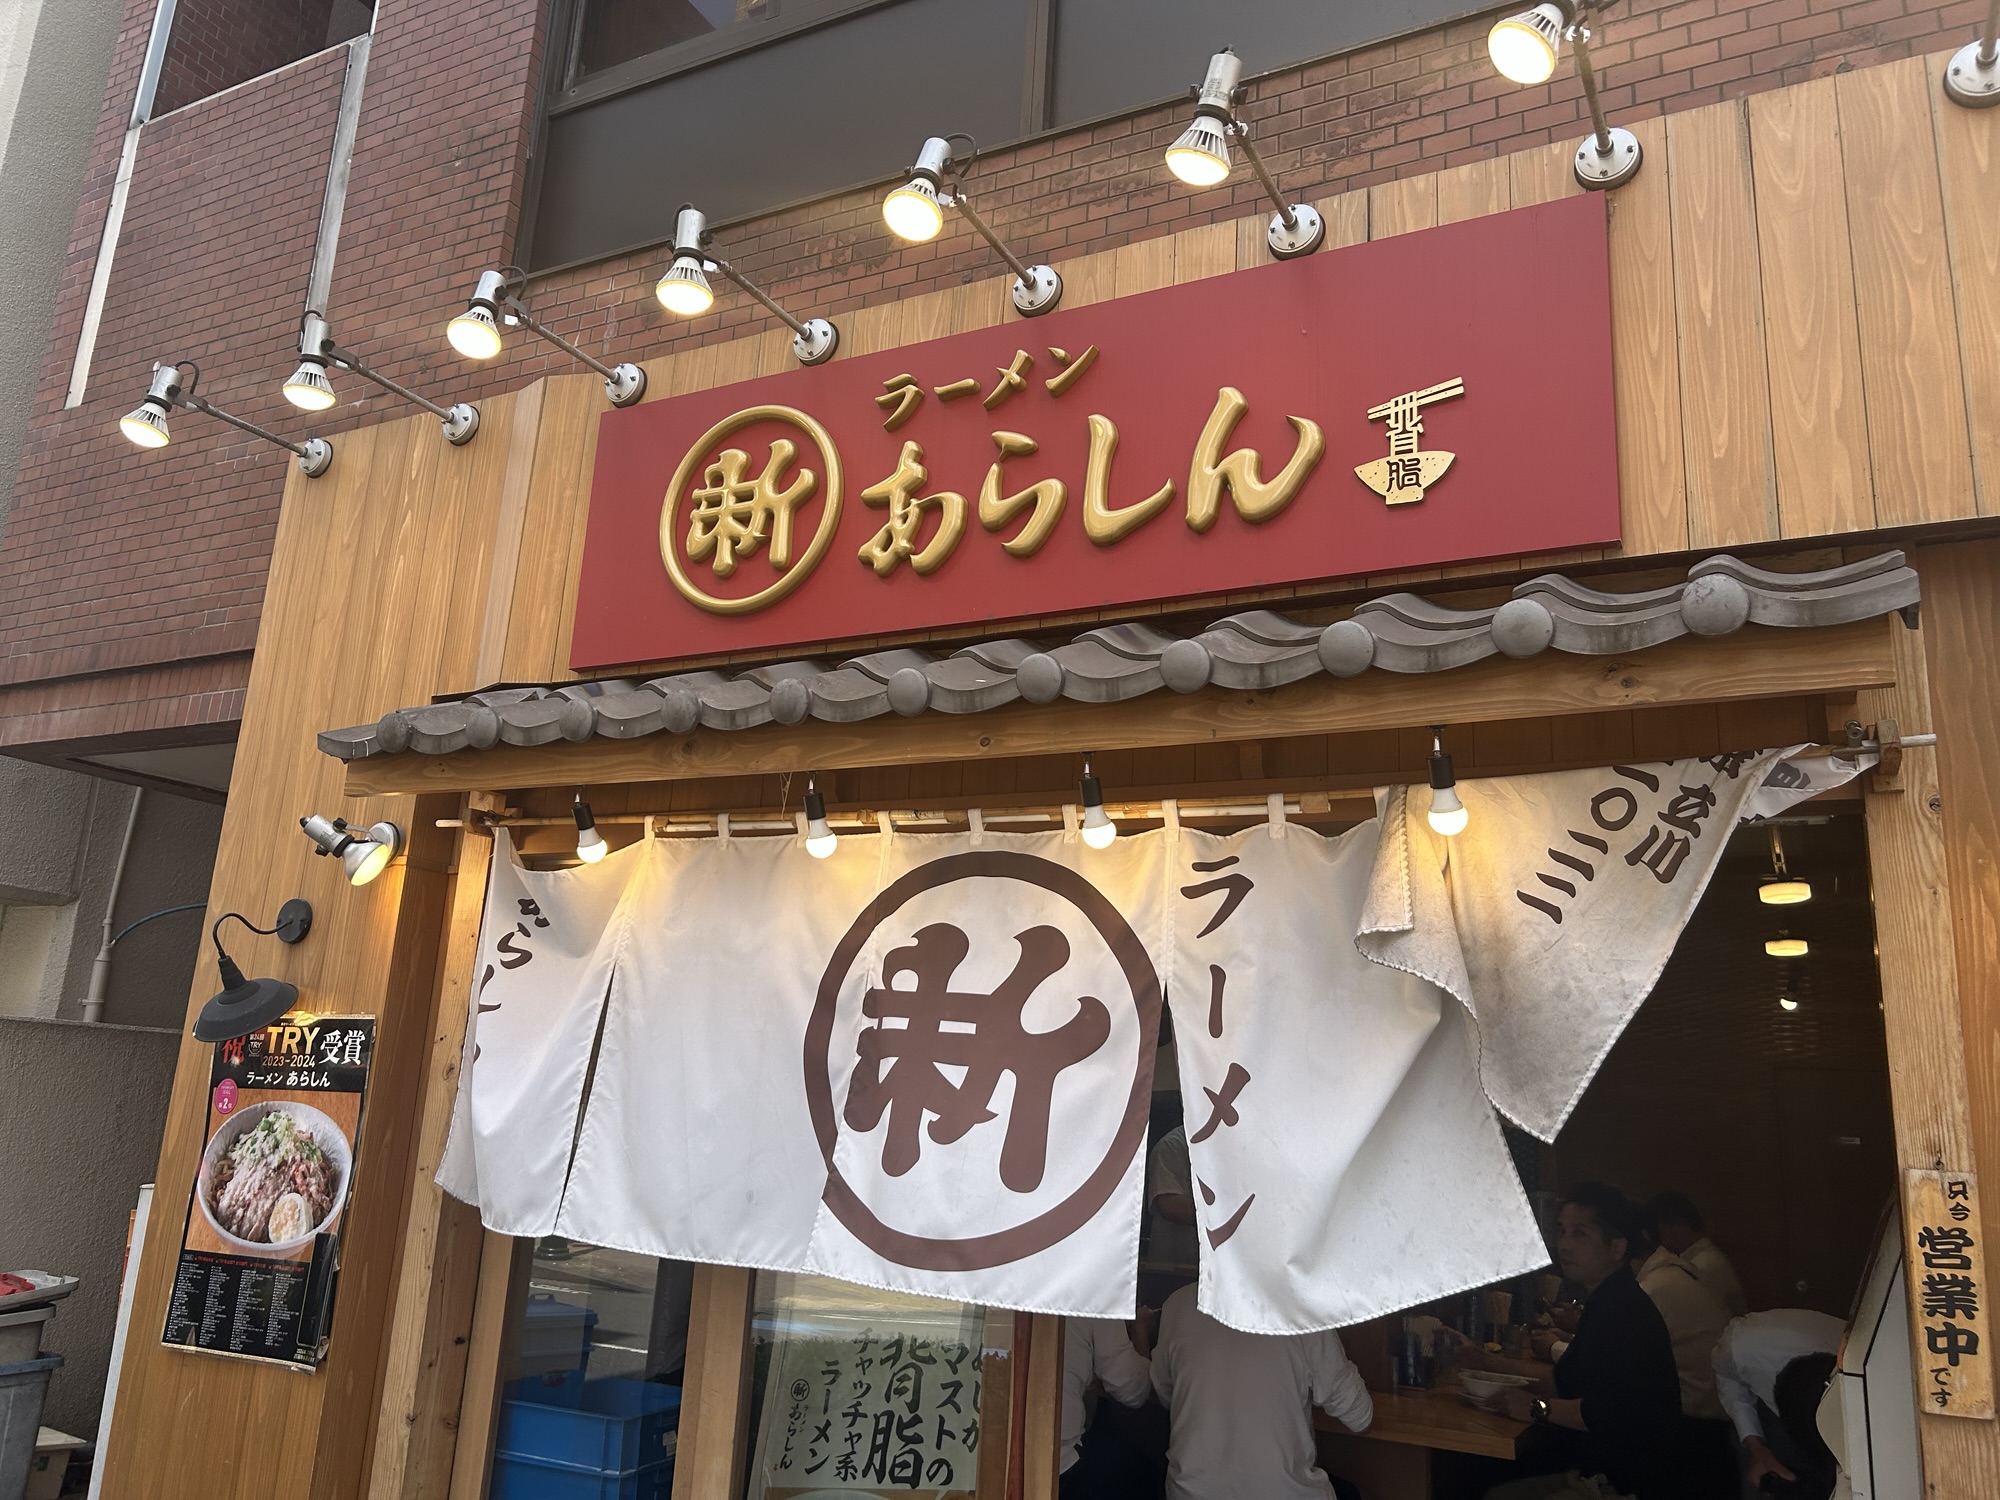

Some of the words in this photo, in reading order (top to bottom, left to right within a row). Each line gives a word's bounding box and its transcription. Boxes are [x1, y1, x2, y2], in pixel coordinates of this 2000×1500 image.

[875, 345, 1100, 432] ラーメン
[858, 386, 1326, 577] あらしん
[246, 1071, 283, 1085] ラーメン
[286, 1070, 331, 1087] あらしん
[262, 1055, 316, 1068] 2023-2024
[267, 1026, 320, 1054] TRY
[318, 1029, 366, 1065] 受賞
[843, 922, 1111, 1194] 新
[1181, 855, 1255, 1252] ラーメン
[780, 1403, 802, 1470] あらしん
[804, 1360, 842, 1476] ラーメン
[833, 1327, 879, 1482] チャッチャ系
[862, 1332, 938, 1489] 背脂
[926, 1342, 970, 1486] マストの
